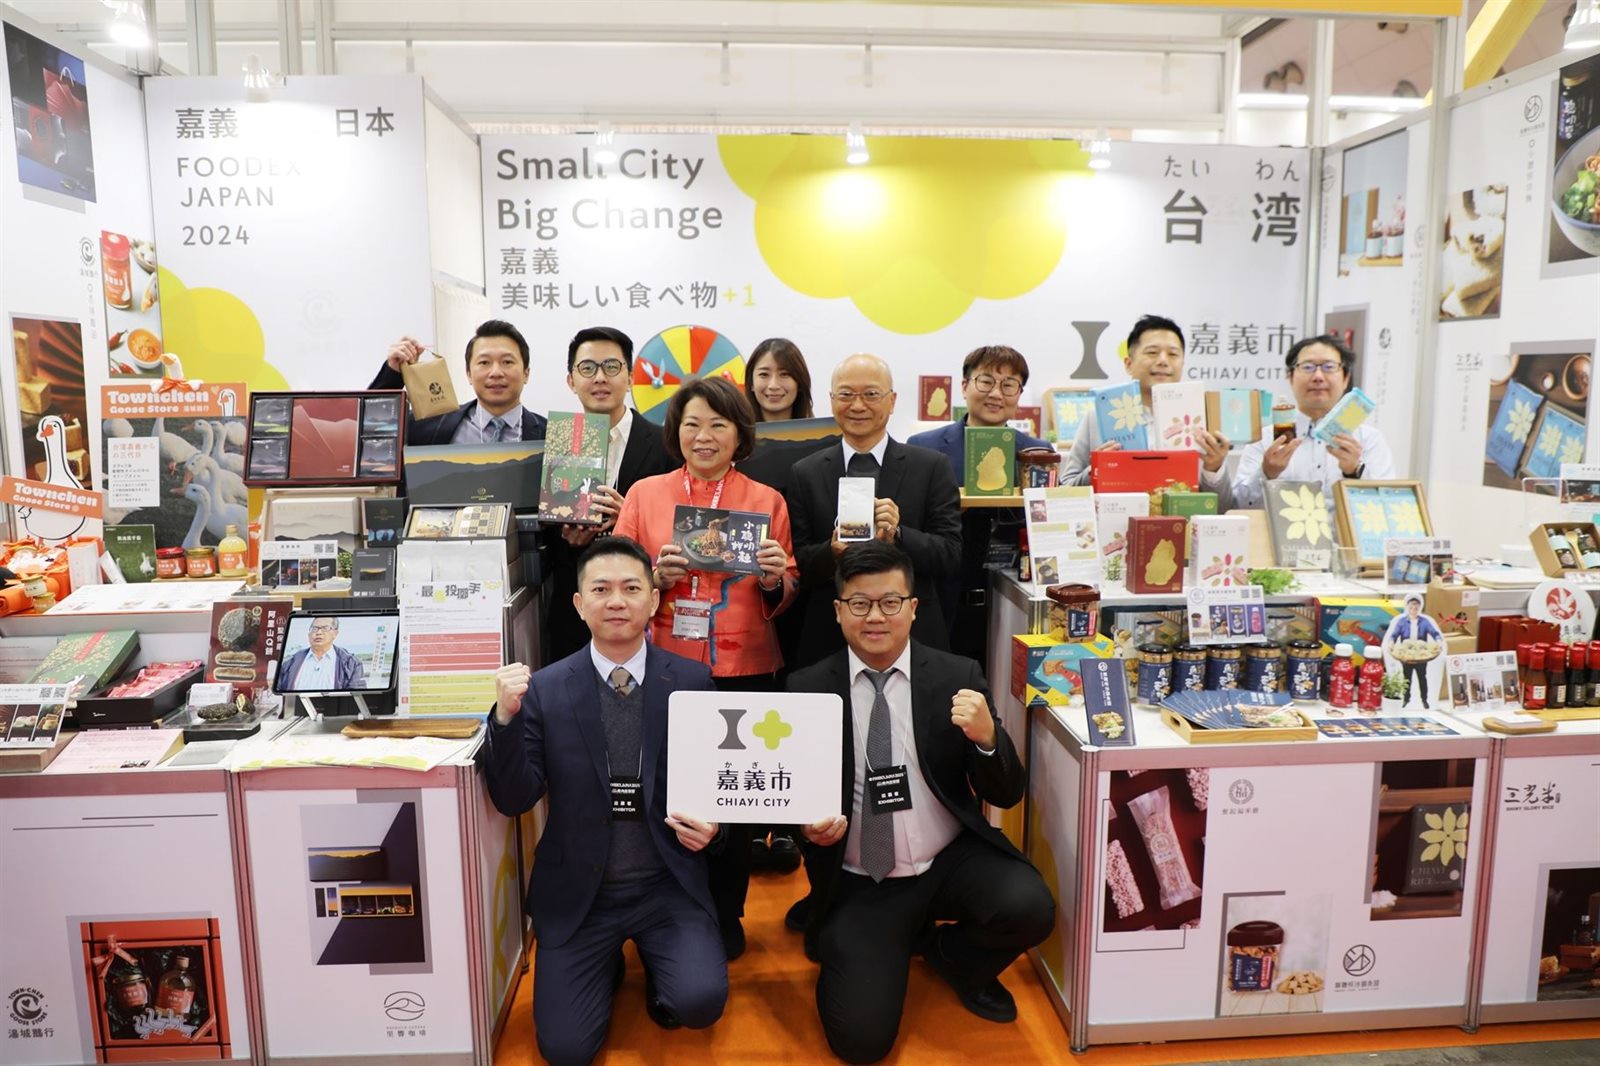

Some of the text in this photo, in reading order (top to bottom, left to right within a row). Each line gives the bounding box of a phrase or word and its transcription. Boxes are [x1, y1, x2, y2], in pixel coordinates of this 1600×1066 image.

[175, 107, 395, 140] 嘉義 日本
[497, 147, 704, 190] Small City
[1163, 156, 1300, 182] たい わん
[180, 186, 275, 208] JAPAN
[498, 197, 723, 241] Big Change
[1163, 189, 1300, 247] 台 湾
[182, 224, 250, 247] 2024
[500, 247, 560, 275] 嘉義
[1189, 323, 1297, 355] 嘉義市
[1188, 367, 1287, 380] CHIAYI CIT
[107, 390, 209, 404] Townchen
[109, 406, 145, 414] Goose
[147, 405, 179, 413] Store
[13, 482, 98, 507] Townchen
[13, 494, 71, 510] Goose Store
[723, 761, 732, 769] か
[751, 761, 760, 769] ぎ
[716, 769, 792, 791] 嘉義市
[716, 797, 791, 807] CHIAYI CITY
